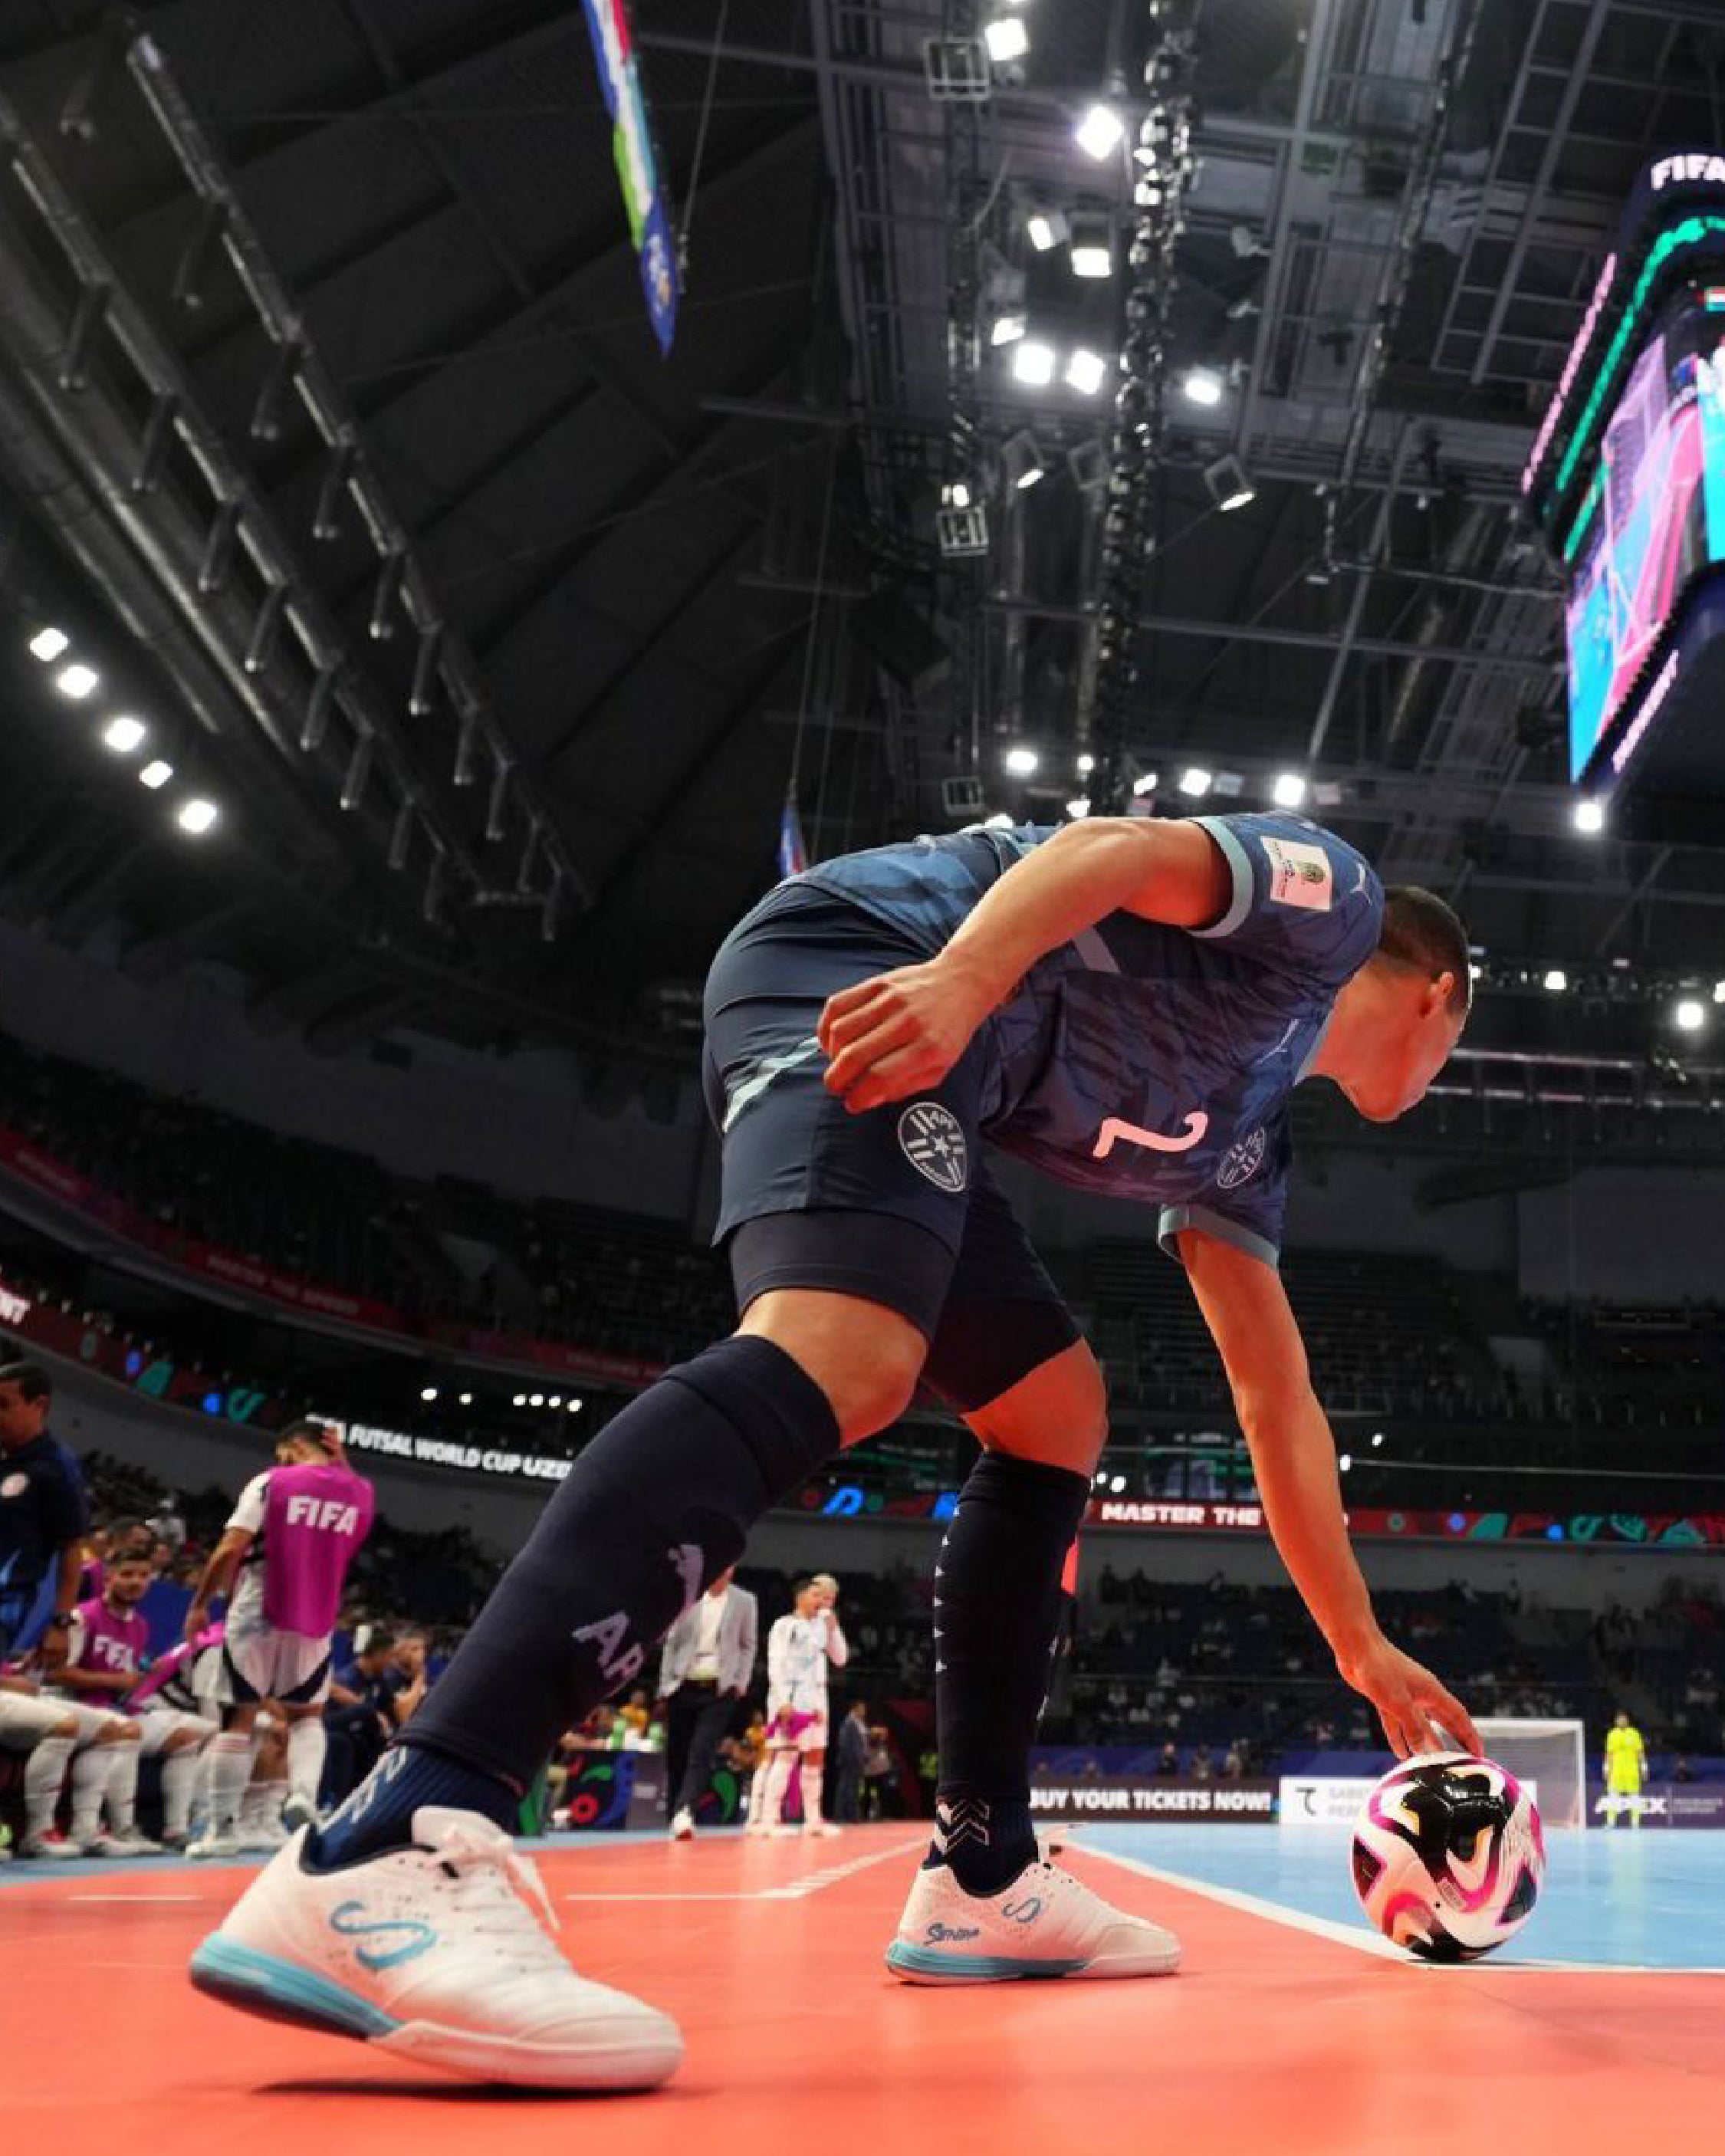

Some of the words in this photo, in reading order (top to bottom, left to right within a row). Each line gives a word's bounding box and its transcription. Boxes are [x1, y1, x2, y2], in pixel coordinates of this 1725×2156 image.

[1092, 1110, 1209, 1159] 2
[349, 1424, 413, 1456] FUTSAL
[414, 1438, 482, 1467] WORLD
[481, 1451, 522, 1474] CUP
[286, 1495, 359, 1537] FIFA
[1100, 1502, 1206, 1523] MASTER
[1213, 1507, 1262, 1526] THE
[93, 1635, 133, 1671] FIFA
[1030, 1788, 1069, 1809] BUY
[1072, 1788, 1129, 1809] YOUR
[1131, 1789, 1211, 1810] TICKETS
